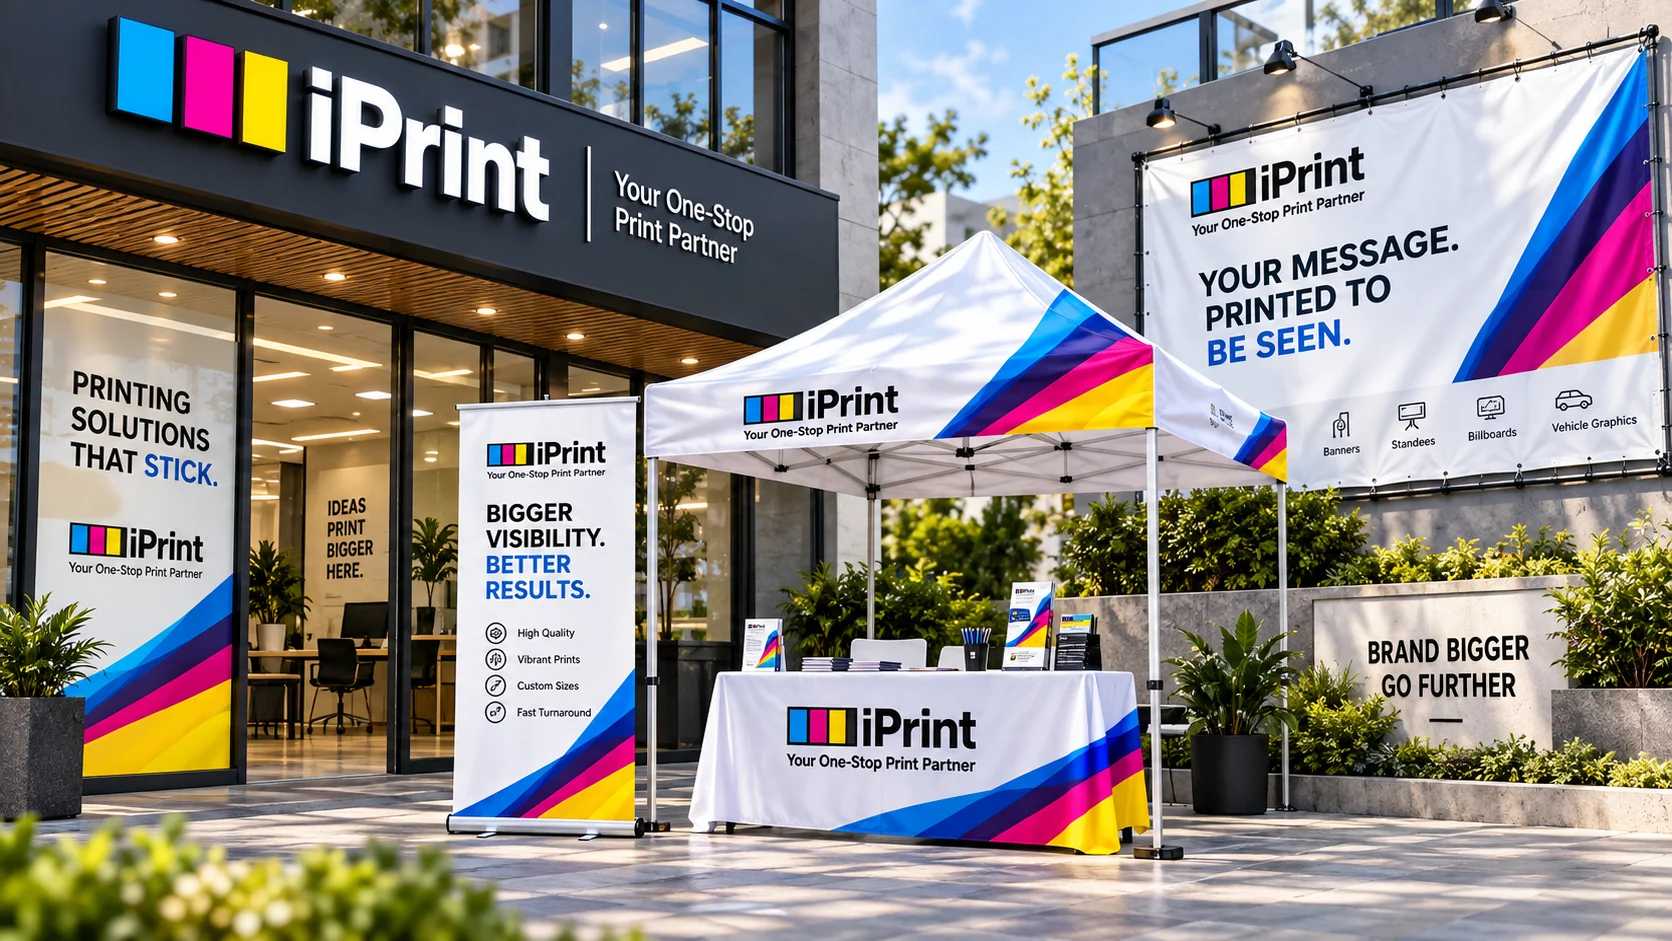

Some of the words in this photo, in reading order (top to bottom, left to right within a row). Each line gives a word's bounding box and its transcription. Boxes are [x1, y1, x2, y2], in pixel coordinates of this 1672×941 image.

[303, 66, 549, 222] iPrint
[1261, 146, 1365, 201] iPrint
[614, 170, 661, 207] Your
[666, 189, 754, 241] One-Stop
[1192, 224, 1218, 236] Your
[1221, 209, 1279, 230] One-Stop
[1283, 201, 1313, 217] Print
[1317, 191, 1365, 209] Partner
[615, 207, 662, 243] Print
[669, 222, 738, 263] Partner
[1199, 259, 1281, 297] YOUR
[1292, 225, 1458, 280] MESSAGE.
[1206, 284, 1336, 332] PRINTED
[1346, 274, 1391, 306] TO
[1208, 335, 1246, 366] BE
[1256, 319, 1351, 358] SEEN.
[73, 370, 190, 414] PRINTING
[808, 385, 898, 419] iPrint
[71, 406, 209, 451] SOLUTIONS
[744, 430, 768, 439] Your
[771, 426, 823, 438] One-Stop
[827, 424, 853, 434] Print
[856, 421, 898, 432] Partner
[1552, 420, 1589, 433] Vehicle
[1591, 415, 1637, 429] Graphics
[1392, 437, 1436, 449] Standees
[1468, 427, 1517, 441] Billboards
[537, 441, 606, 465] iPrint
[1323, 445, 1360, 456] Banners
[70, 442, 138, 474] THAT
[144, 454, 217, 487] STICK.
[487, 471, 506, 479] Your
[508, 470, 549, 479] One-Stop
[551, 469, 571, 477] Print
[328, 498, 366, 516] IDEAS
[487, 503, 572, 522] BIGGER
[328, 519, 365, 537] PRINT
[130, 528, 203, 562] iPrint
[486, 528, 605, 548] VISIBILITY.
[327, 540, 373, 558] BIGGER
[69, 562, 92, 574] Your
[96, 563, 142, 578] One-Stop
[145, 567, 167, 577] Print
[170, 568, 202, 579] Partner
[327, 562, 363, 579] HERE.
[486, 555, 571, 574] BETTER
[486, 580, 590, 599] RESULTS.
[518, 629, 539, 639] High
[542, 628, 575, 639] Quality
[517, 655, 551, 663] Vibrant
[554, 655, 580, 663] Prints
[1368, 639, 1439, 664] BRAND
[1447, 635, 1529, 662] BIGGER
[517, 681, 553, 690] Custom
[555, 681, 579, 690] Sizes
[1382, 674, 1411, 698] GO
[1419, 672, 1515, 697] FURTHER
[517, 708, 536, 717] Fast
[539, 708, 591, 717] Turnaround
[863, 708, 976, 749] iPrint
[787, 754, 816, 766] Your
[819, 755, 882, 772] One-Stop
[886, 757, 918, 770] Print
[923, 758, 975, 772] Partner
